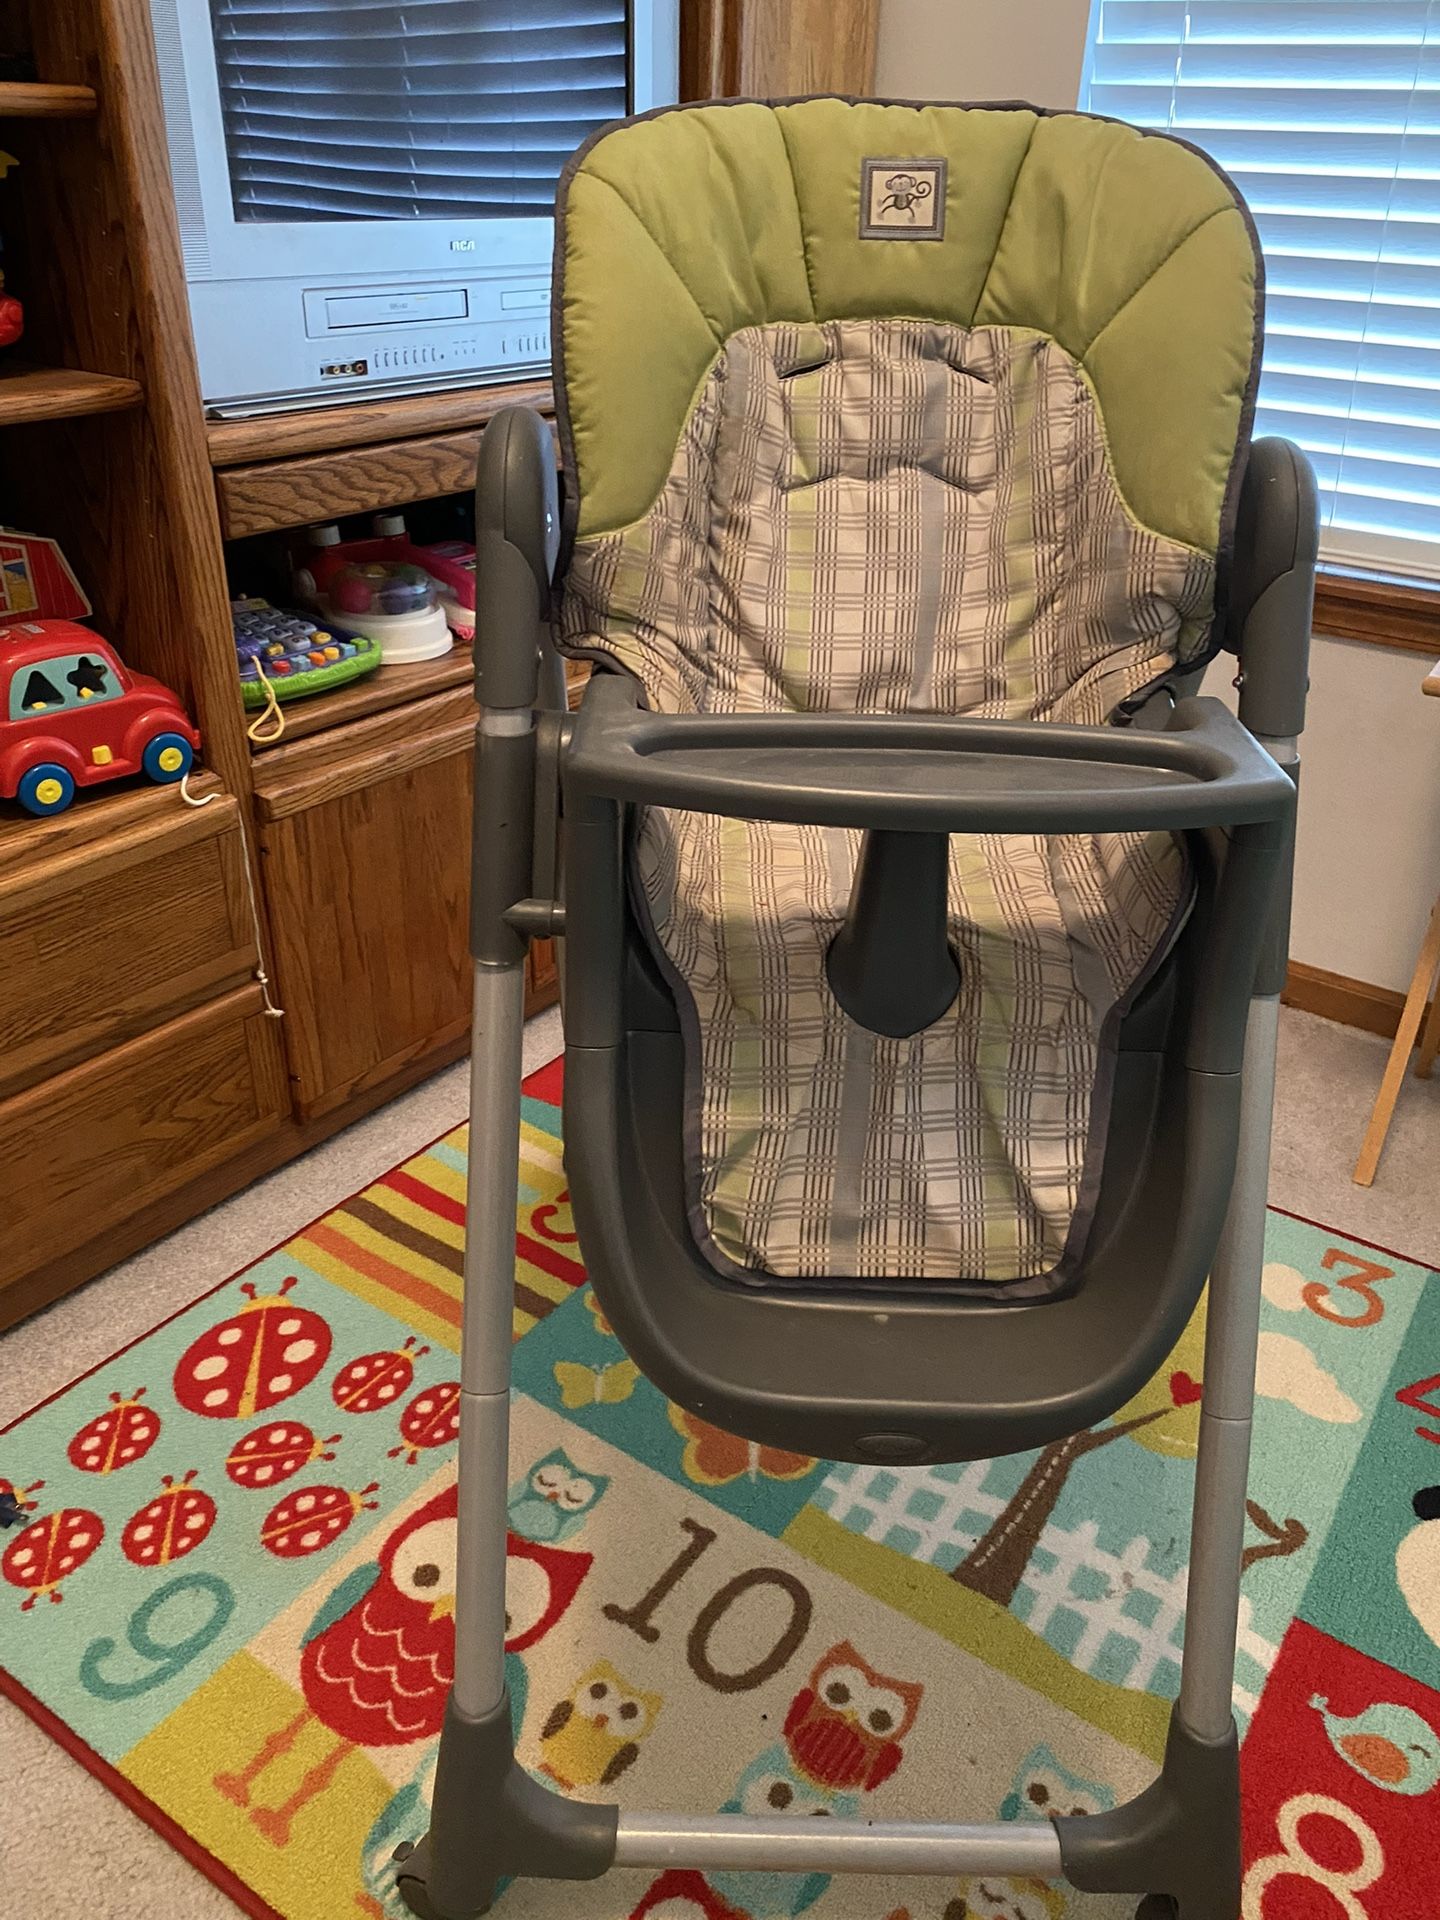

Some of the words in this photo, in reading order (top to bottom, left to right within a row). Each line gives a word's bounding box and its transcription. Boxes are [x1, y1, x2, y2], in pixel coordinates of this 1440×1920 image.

[450, 240, 475, 251] RCA
[1302, 1248, 1396, 1328] 3
[79, 1571, 235, 1702] 9
[602, 1517, 813, 1694] 10
[1240, 1792, 1385, 1920] 8
